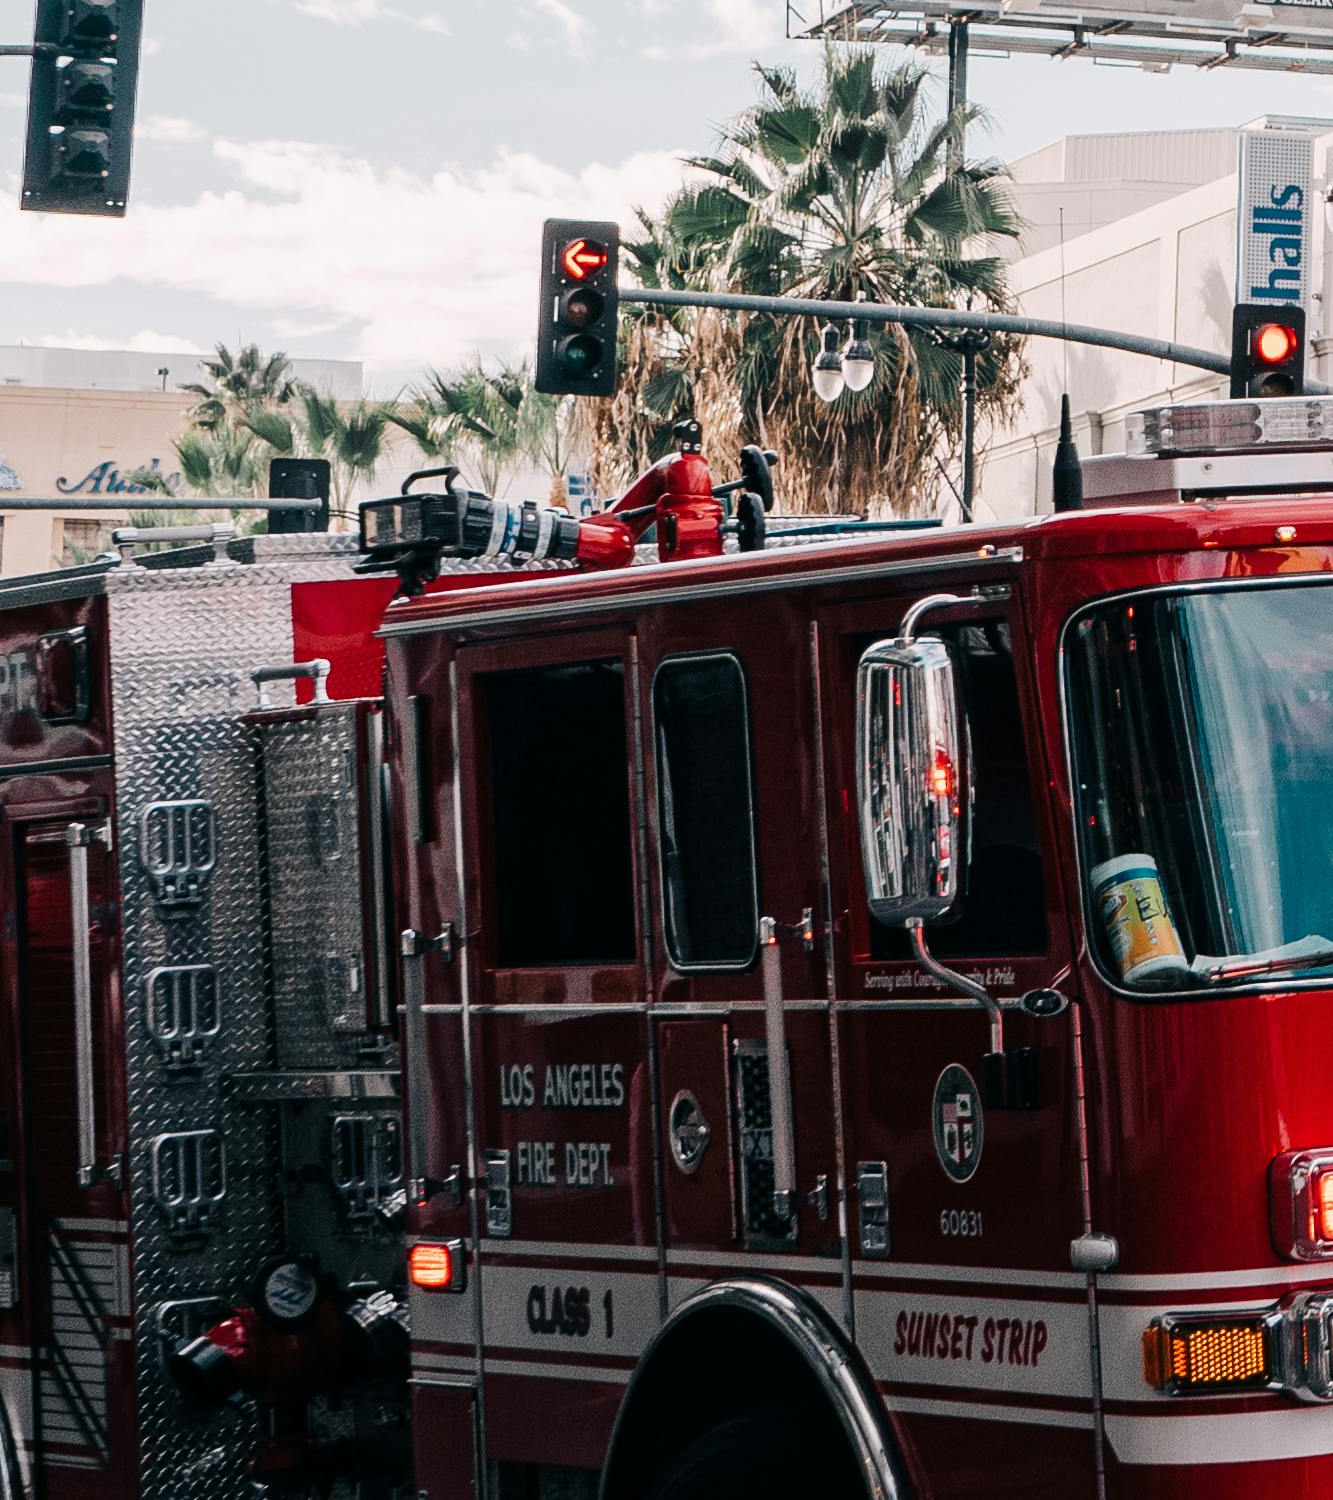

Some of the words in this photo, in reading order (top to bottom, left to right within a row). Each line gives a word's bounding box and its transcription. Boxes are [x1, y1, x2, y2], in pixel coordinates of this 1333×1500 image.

[1251, 184, 1303, 306] halls
[500, 1064, 535, 1106] LOS
[543, 1064, 625, 1106] ANGELES
[518, 1142, 556, 1183] FIRE
[565, 1143, 615, 1185] DEPT.
[940, 1209, 983, 1236] 60831
[527, 1285, 592, 1337] CLASS
[603, 1289, 615, 1339] 1
[894, 1309, 978, 1361] SUNSET
[981, 1317, 1049, 1368] STRIP
